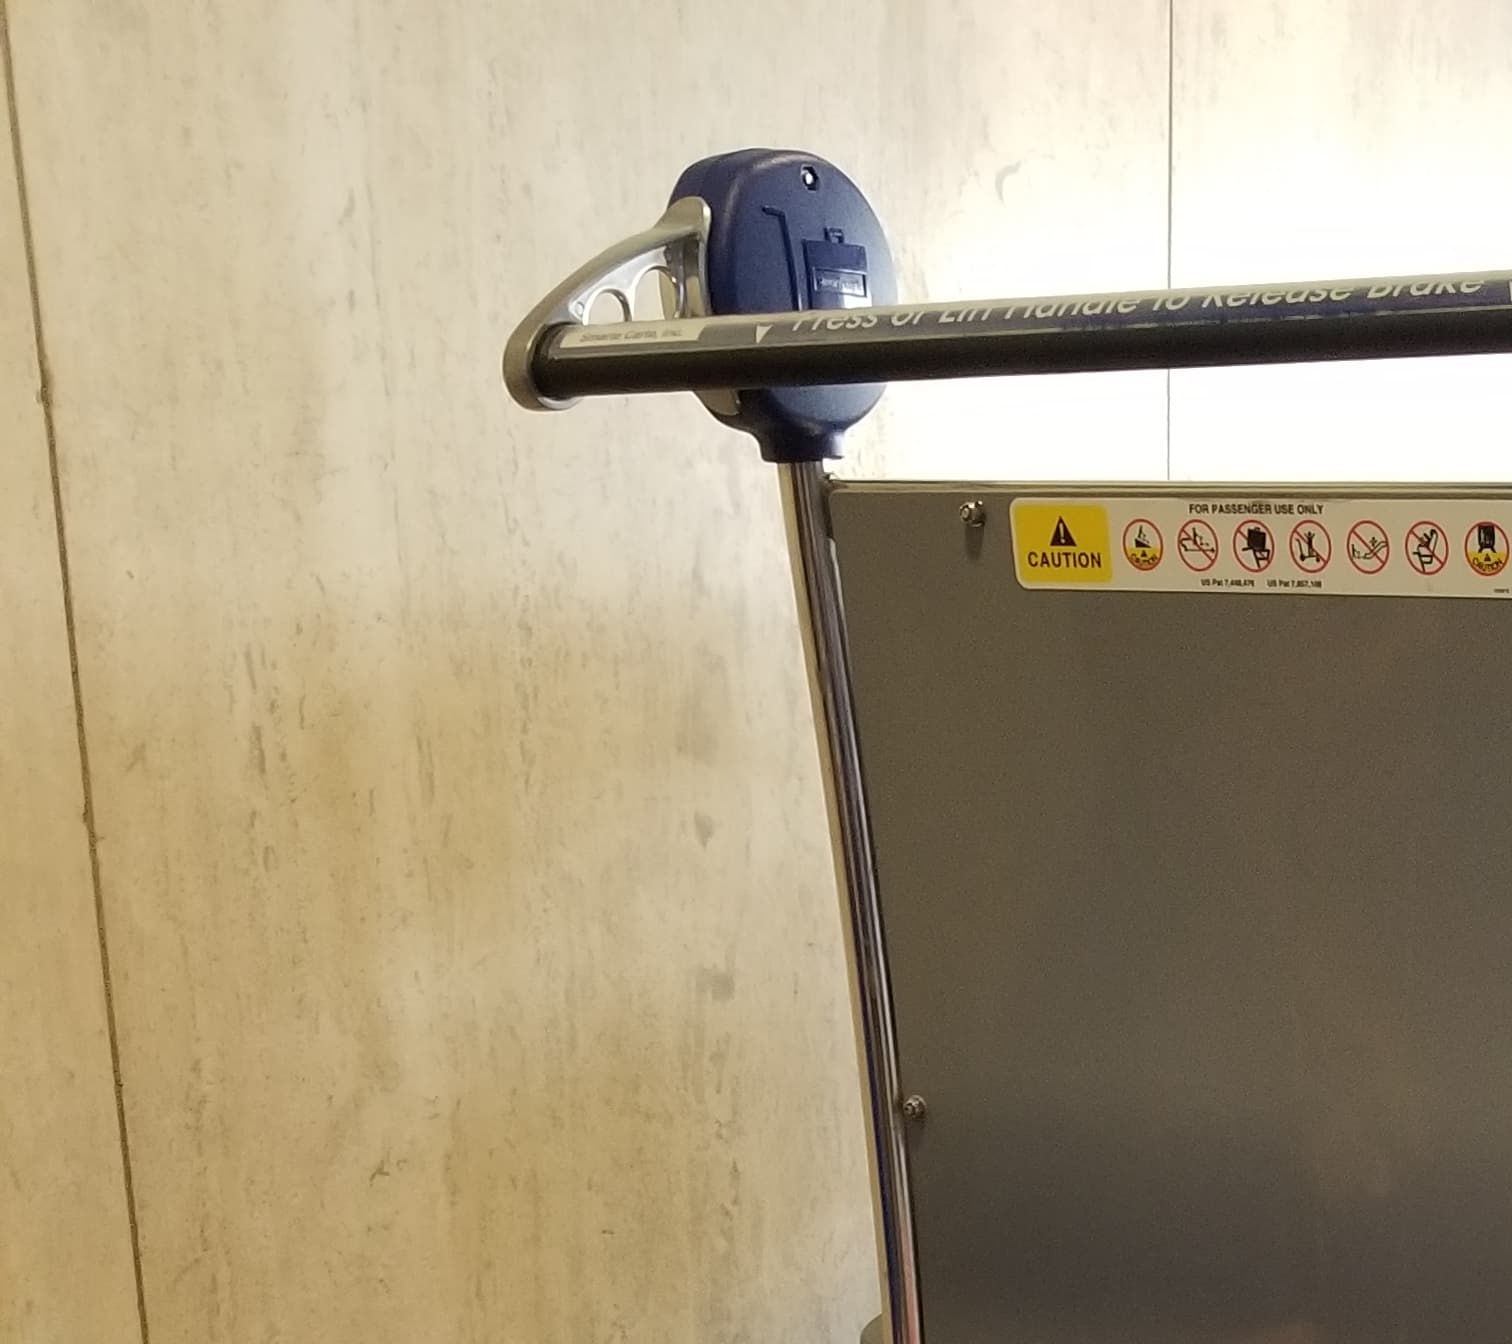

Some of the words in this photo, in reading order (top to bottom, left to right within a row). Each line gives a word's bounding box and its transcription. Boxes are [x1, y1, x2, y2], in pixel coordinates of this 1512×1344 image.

[1189, 503, 1210, 515] FOR
[1211, 503, 1272, 515] PASSENGER
[1274, 503, 1295, 515] USE
[1296, 504, 1324, 515] ONLY
[1027, 551, 1102, 568] CAUTION
